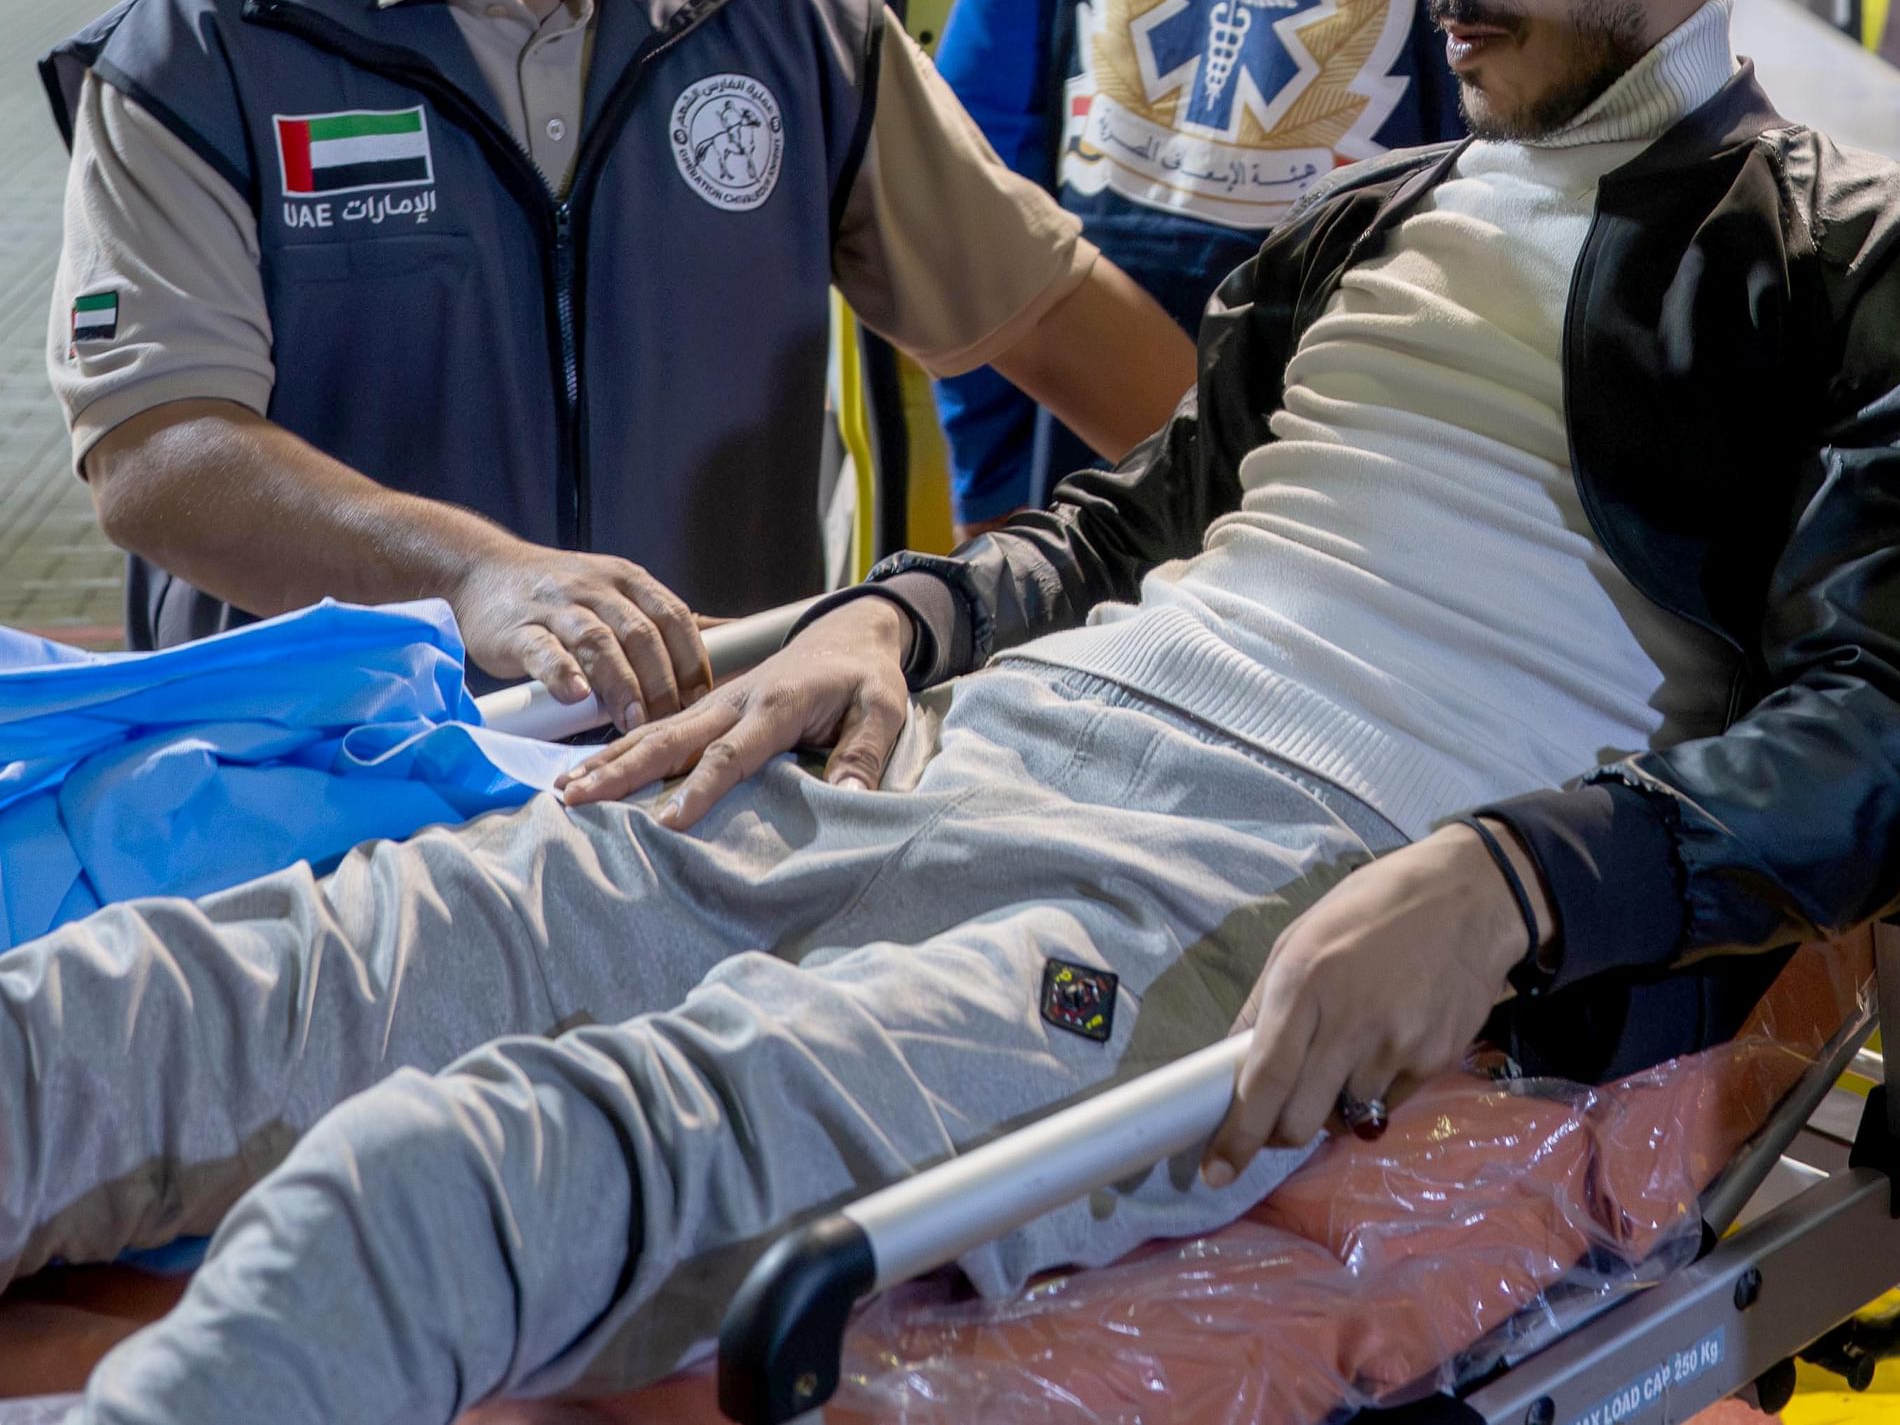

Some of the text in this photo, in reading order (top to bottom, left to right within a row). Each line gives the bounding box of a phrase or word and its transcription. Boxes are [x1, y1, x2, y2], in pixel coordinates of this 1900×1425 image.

[702, 77, 746, 96] الفارس
[678, 147, 723, 202] OPERATION
[283, 202, 334, 228] UAE
[342, 190, 437, 225] الإمارات
[1603, 1384, 1641, 1425] LOAD
[1643, 1363, 1671, 1401] CAP
[1674, 1348, 1698, 1383] 250
[1700, 1340, 1719, 1367] Kg
